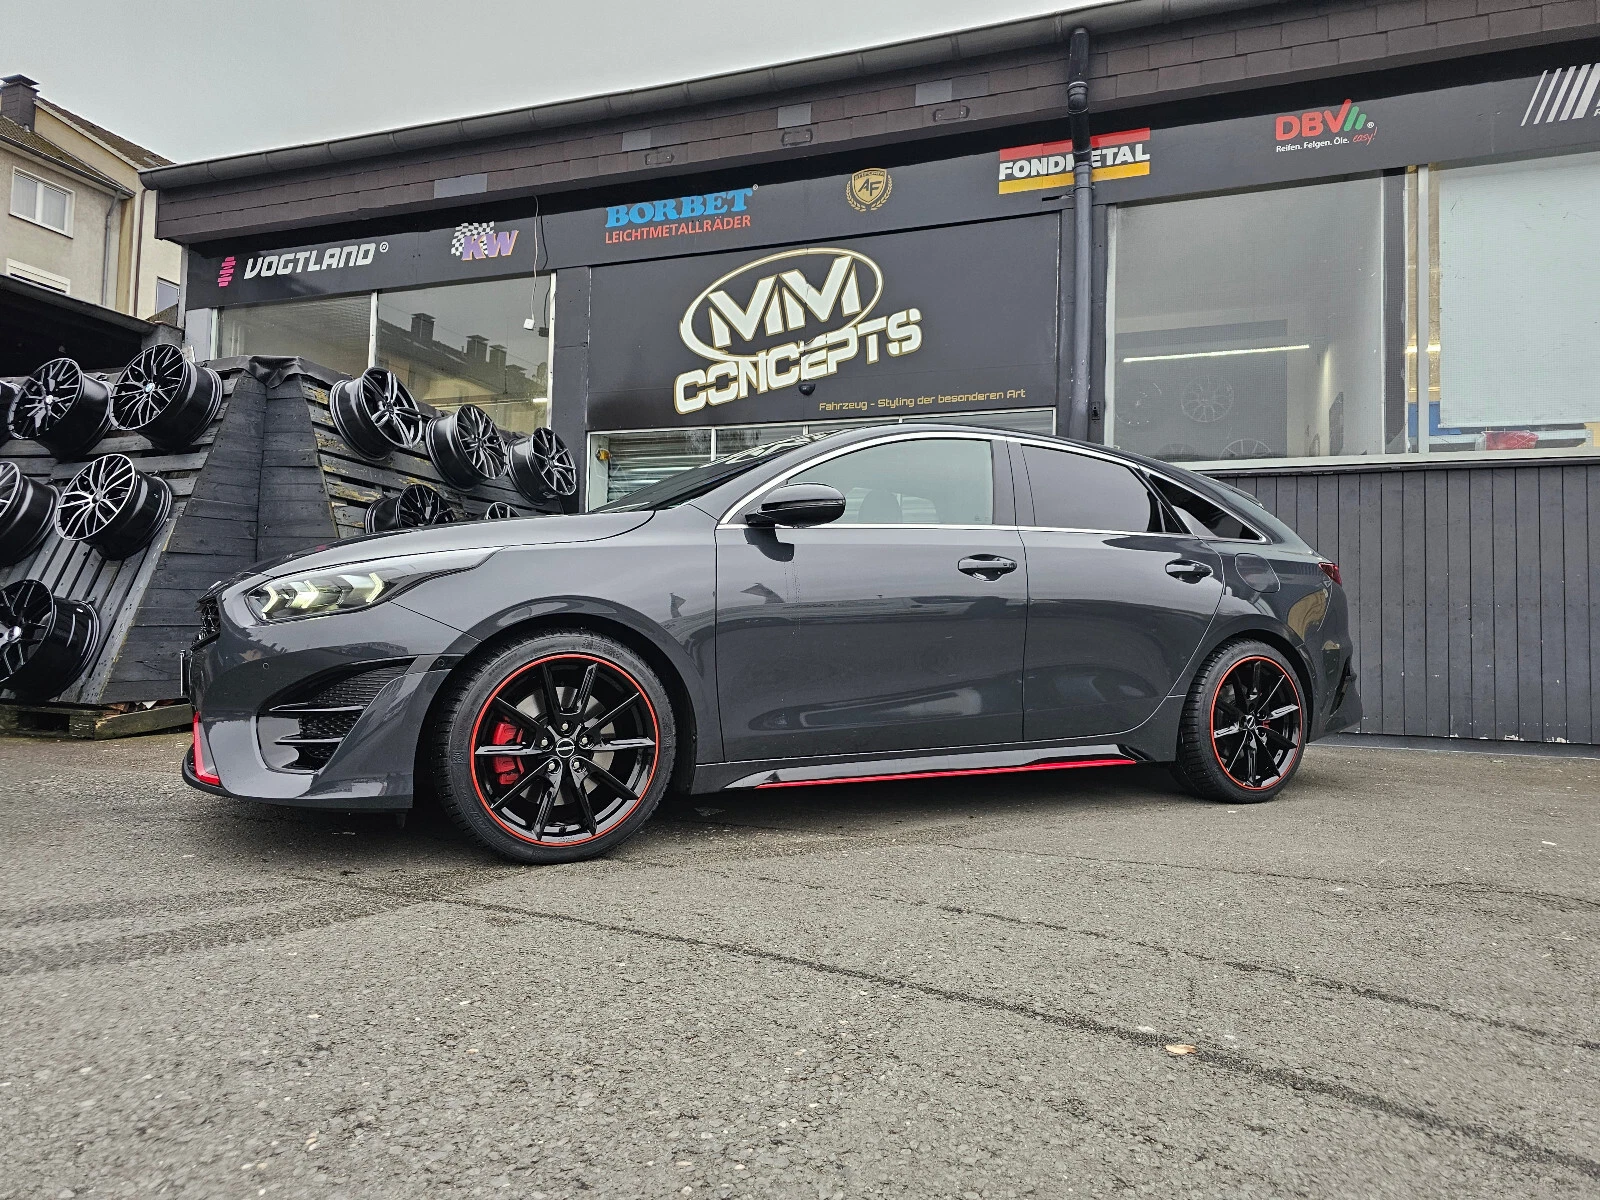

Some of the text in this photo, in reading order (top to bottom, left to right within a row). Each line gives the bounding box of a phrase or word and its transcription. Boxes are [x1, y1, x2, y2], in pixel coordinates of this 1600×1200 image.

[1276, 136, 1350, 153] Reifen. Felgen. Öle.
[857, 178, 883, 197] AF
[605, 187, 753, 228] BORBET
[605, 214, 751, 244] LEICHTMETALLRÄDER
[461, 229, 519, 261] KW
[243, 242, 376, 280] VOGTLAND
[673, 307, 923, 415] CONCEPTS
[819, 401, 868, 412] Fahrzeug
[877, 397, 915, 409] Styling
[917, 395, 936, 405] der
[938, 391, 1004, 404] besonderen
[1006, 389, 1026, 399] Art
